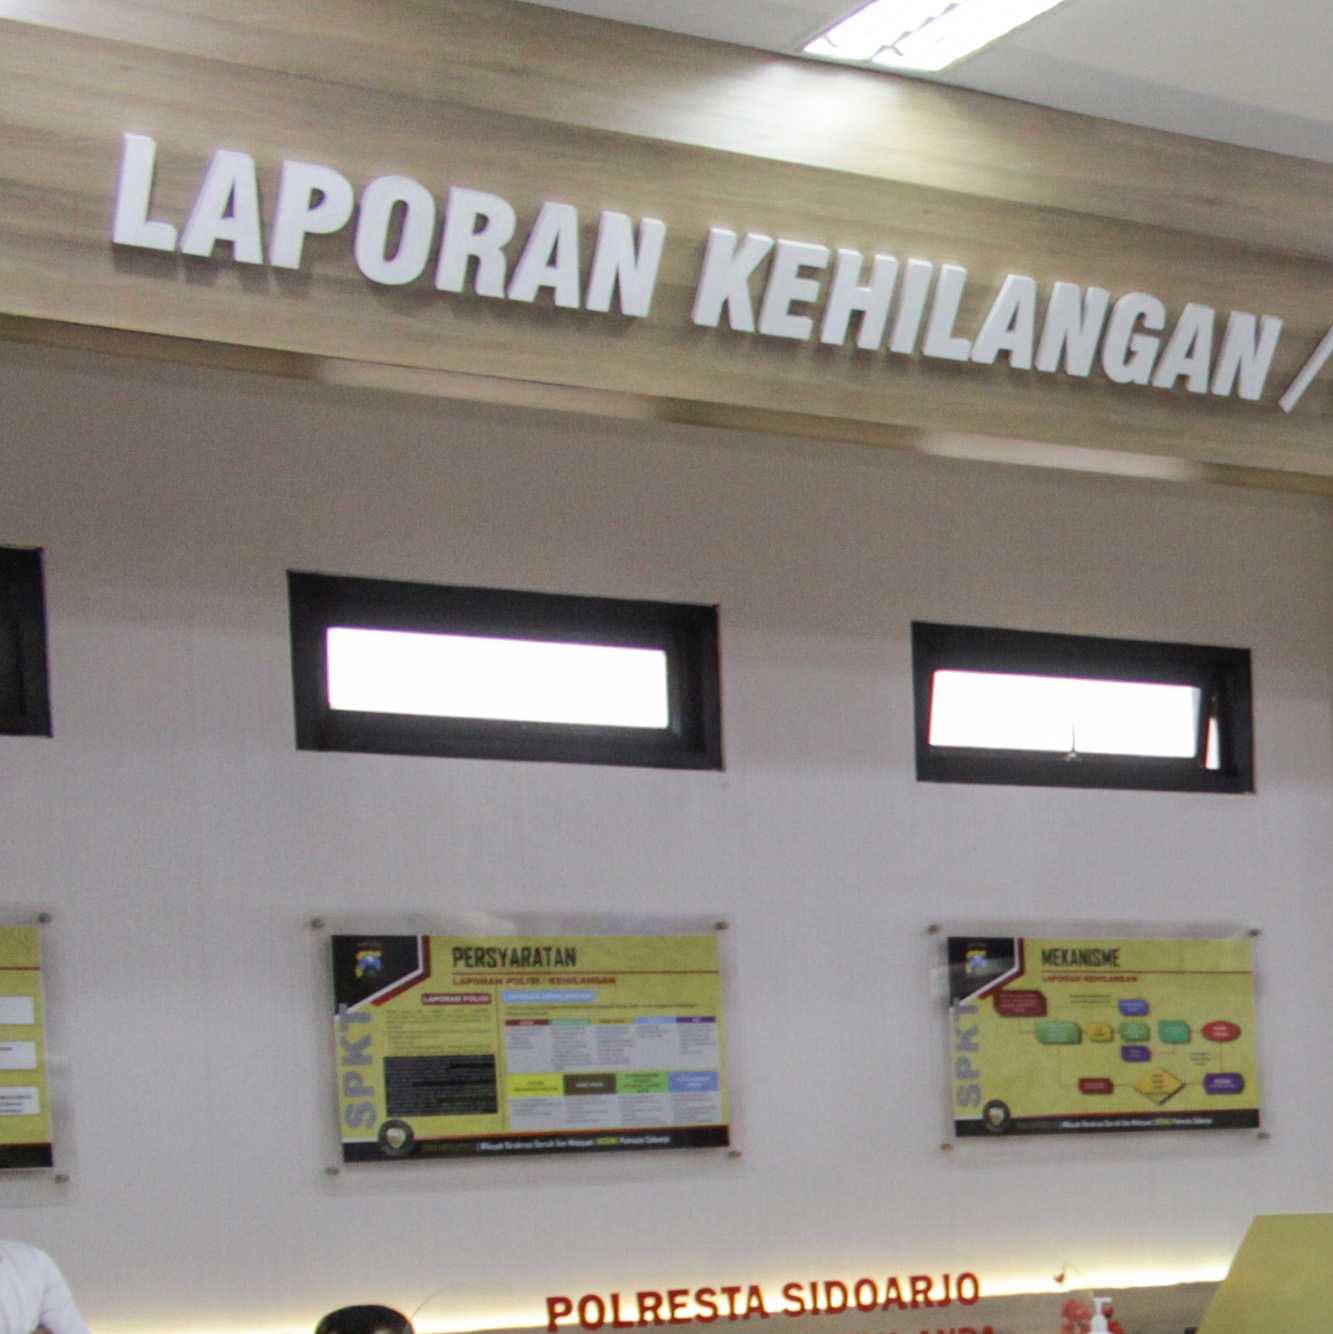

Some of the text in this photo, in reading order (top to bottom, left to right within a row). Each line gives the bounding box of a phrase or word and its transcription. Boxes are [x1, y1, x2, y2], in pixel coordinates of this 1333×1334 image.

[112, 132, 666, 317] LAPORAN
[692, 227, 1282, 402] KEHILANGAN
[452, 946, 577, 968] PERSYARATAN
[1041, 947, 1121, 968] MEKANISME
[545, 1272, 982, 1333] POLRESTA SIDOARJO
